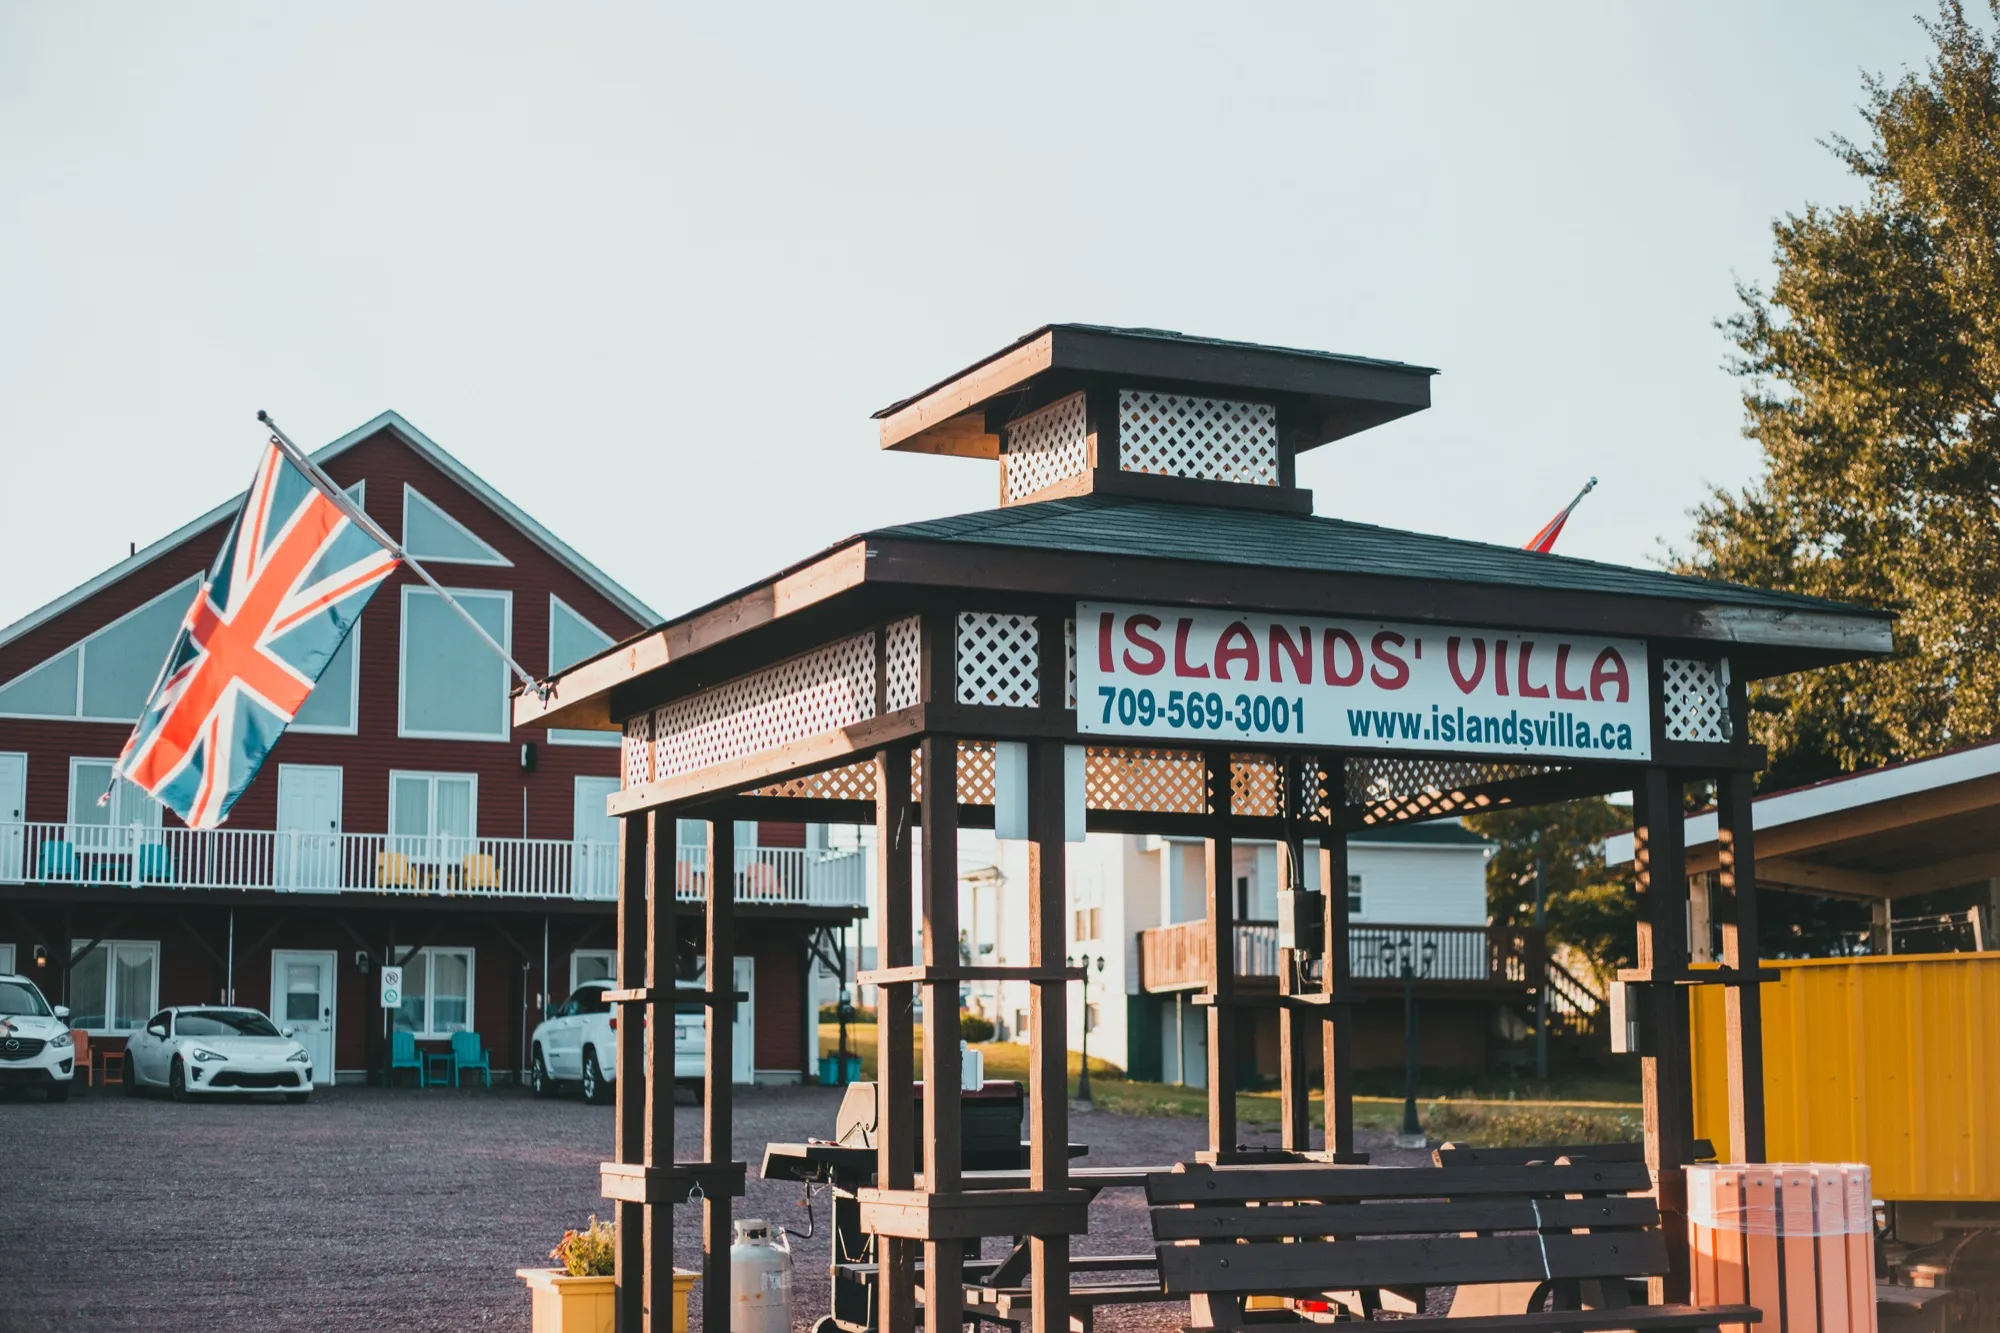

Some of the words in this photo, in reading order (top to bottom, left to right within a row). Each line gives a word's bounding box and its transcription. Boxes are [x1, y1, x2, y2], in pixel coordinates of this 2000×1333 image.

[1098, 611, 1422, 690] ISLANDS'
[1446, 635, 1630, 703] VILLA
[1098, 686, 1304, 734] 709-569-3001
[1346, 704, 1633, 751] www.islandsvilla.ca
